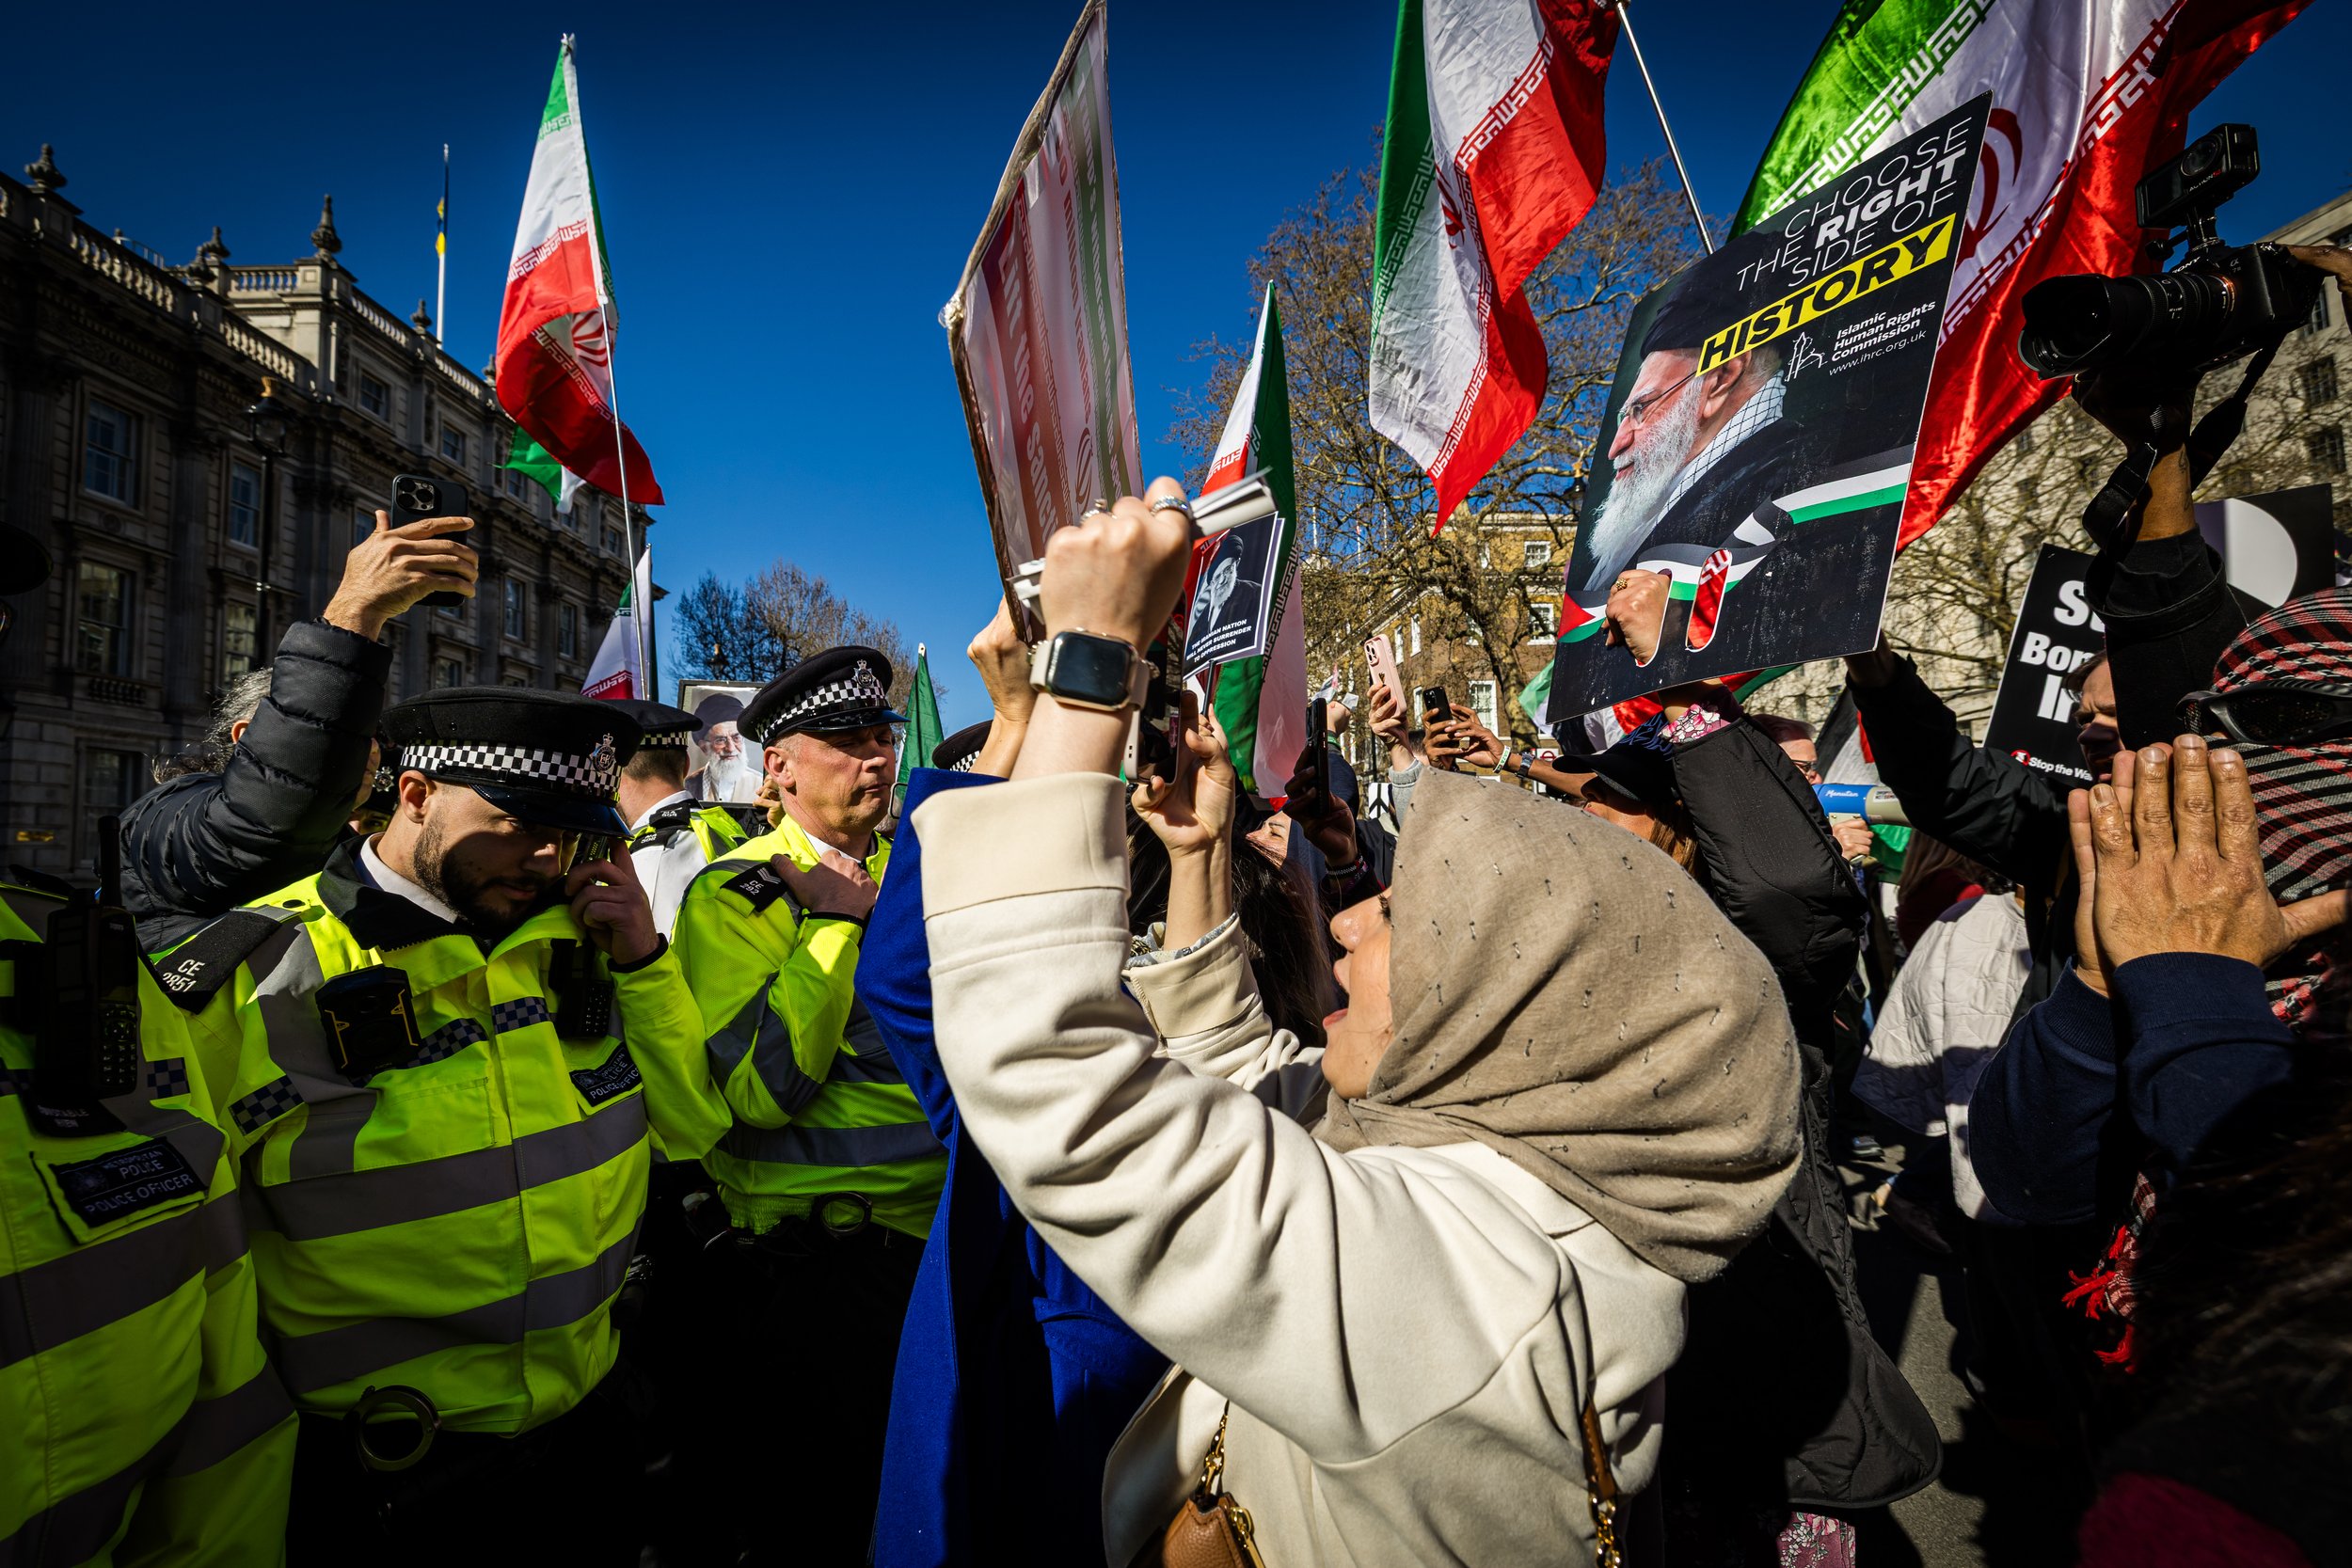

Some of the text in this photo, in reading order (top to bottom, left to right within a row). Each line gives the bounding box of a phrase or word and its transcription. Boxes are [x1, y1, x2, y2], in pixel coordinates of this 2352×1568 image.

[1785, 117, 1972, 238] CHOOSE
[1737, 235, 1804, 291] THE
[1815, 148, 1966, 249] RIGHT
[1788, 181, 1958, 287] SIDE OF
[1063, 189, 1078, 311] million
[1074, 306, 1091, 424] Iranians
[1700, 219, 1951, 372] HISTORY
[1832, 318, 1921, 361] Commission
[1834, 301, 1936, 351] Human Rights
[1836, 311, 1886, 340] Islamic
[1091, 213, 1110, 363] withdrawal
[1110, 453, 1123, 501] JCPO
[1829, 330, 1927, 376] www.ihrc.org.uk
[1014, 331, 1034, 423] the
[1197, 641, 1213, 654] NEVER
[1214, 626, 1252, 643] SURRENDER
[1200, 639, 1236, 658] OPPRESSION
[1201, 627, 1222, 643] IRANIAN
[1222, 619, 1248, 632] NATION
[2028, 756, 2093, 782] Stop the Wa
[1825, 789, 1859, 798] Manutan
[749, 879, 764, 890] CE
[177, 958, 206, 976] CE
[589, 1082, 619, 1099] POLICE
[119, 1159, 165, 1179] POLICE
[84, 1173, 194, 1213] POLICE OFFICER
